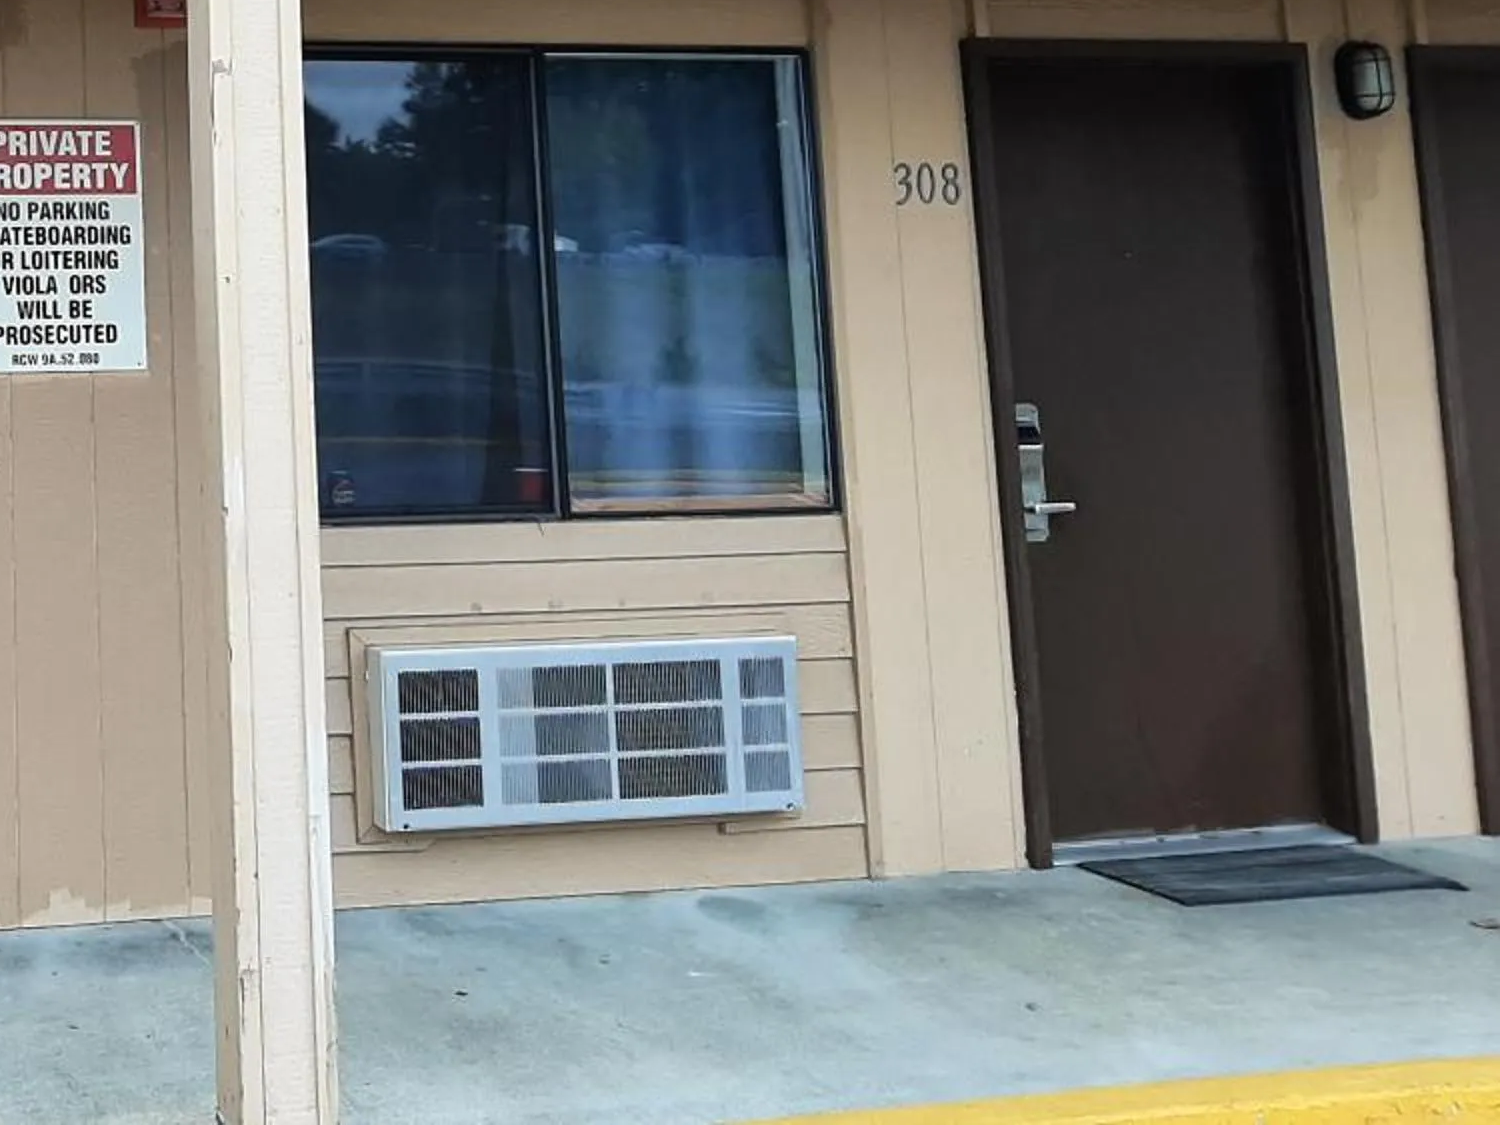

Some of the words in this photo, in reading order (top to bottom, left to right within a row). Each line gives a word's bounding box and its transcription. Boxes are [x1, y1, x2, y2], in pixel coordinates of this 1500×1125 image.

[894, 162, 961, 206] 308
[27, 200, 110, 221] PARKING
[21, 250, 119, 270] LOITERING
[17, 300, 62, 320] WILL
[69, 299, 92, 319] BE
[11, 353, 39, 366] RCW
